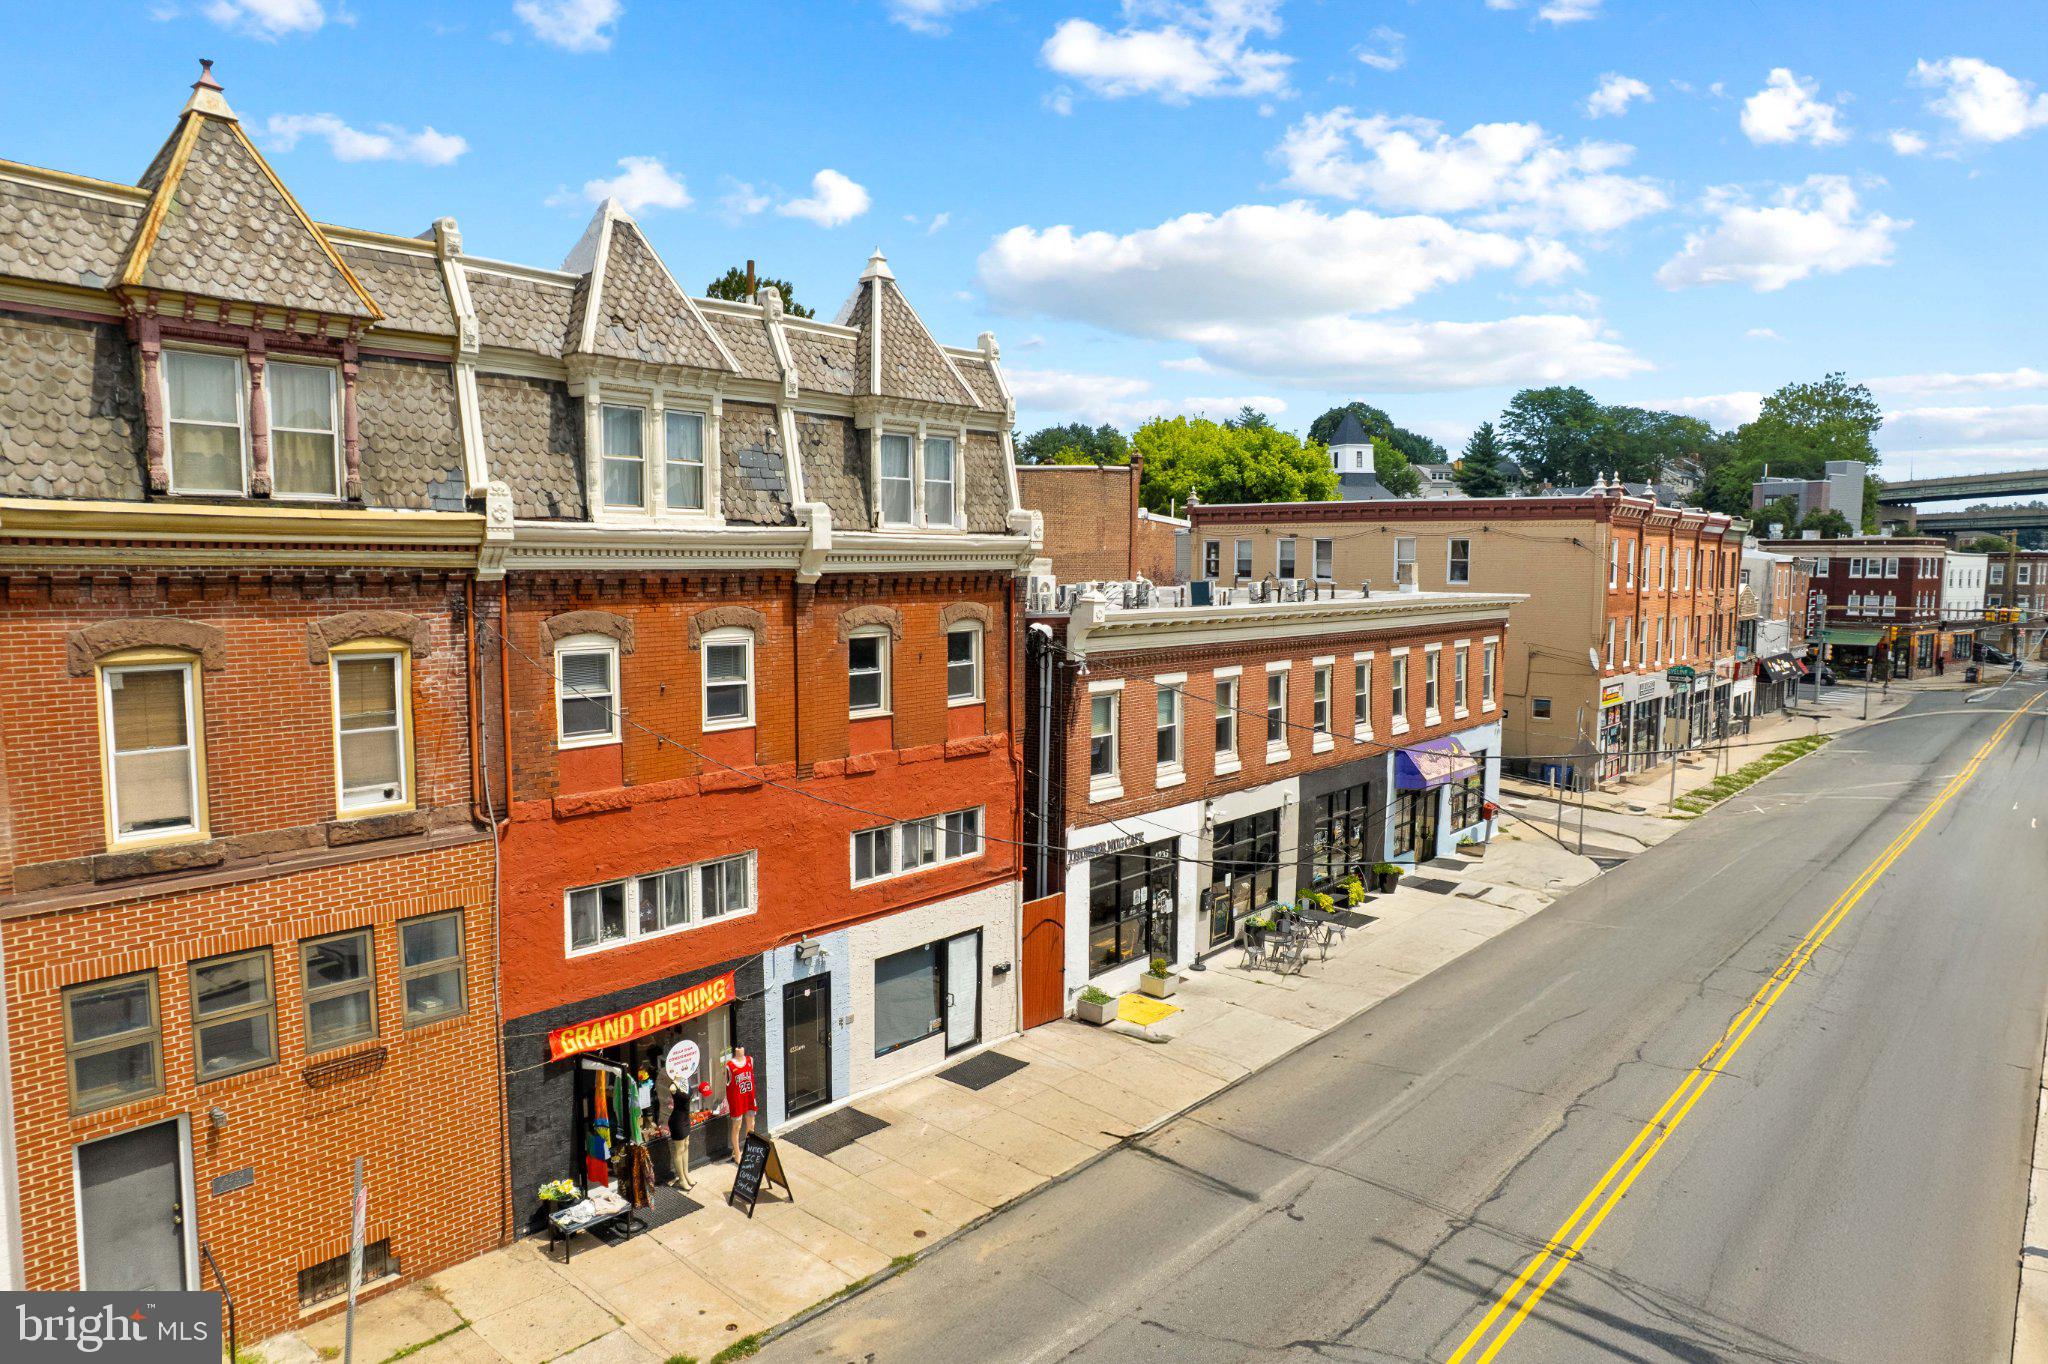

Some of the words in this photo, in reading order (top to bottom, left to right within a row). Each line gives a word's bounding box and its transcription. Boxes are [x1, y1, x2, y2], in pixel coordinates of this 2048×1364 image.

[560, 1013, 634, 1054] GRAND
[640, 978, 727, 1031] OPENING
[739, 1081, 752, 1094] 23
[744, 1154, 761, 1163] ICE
